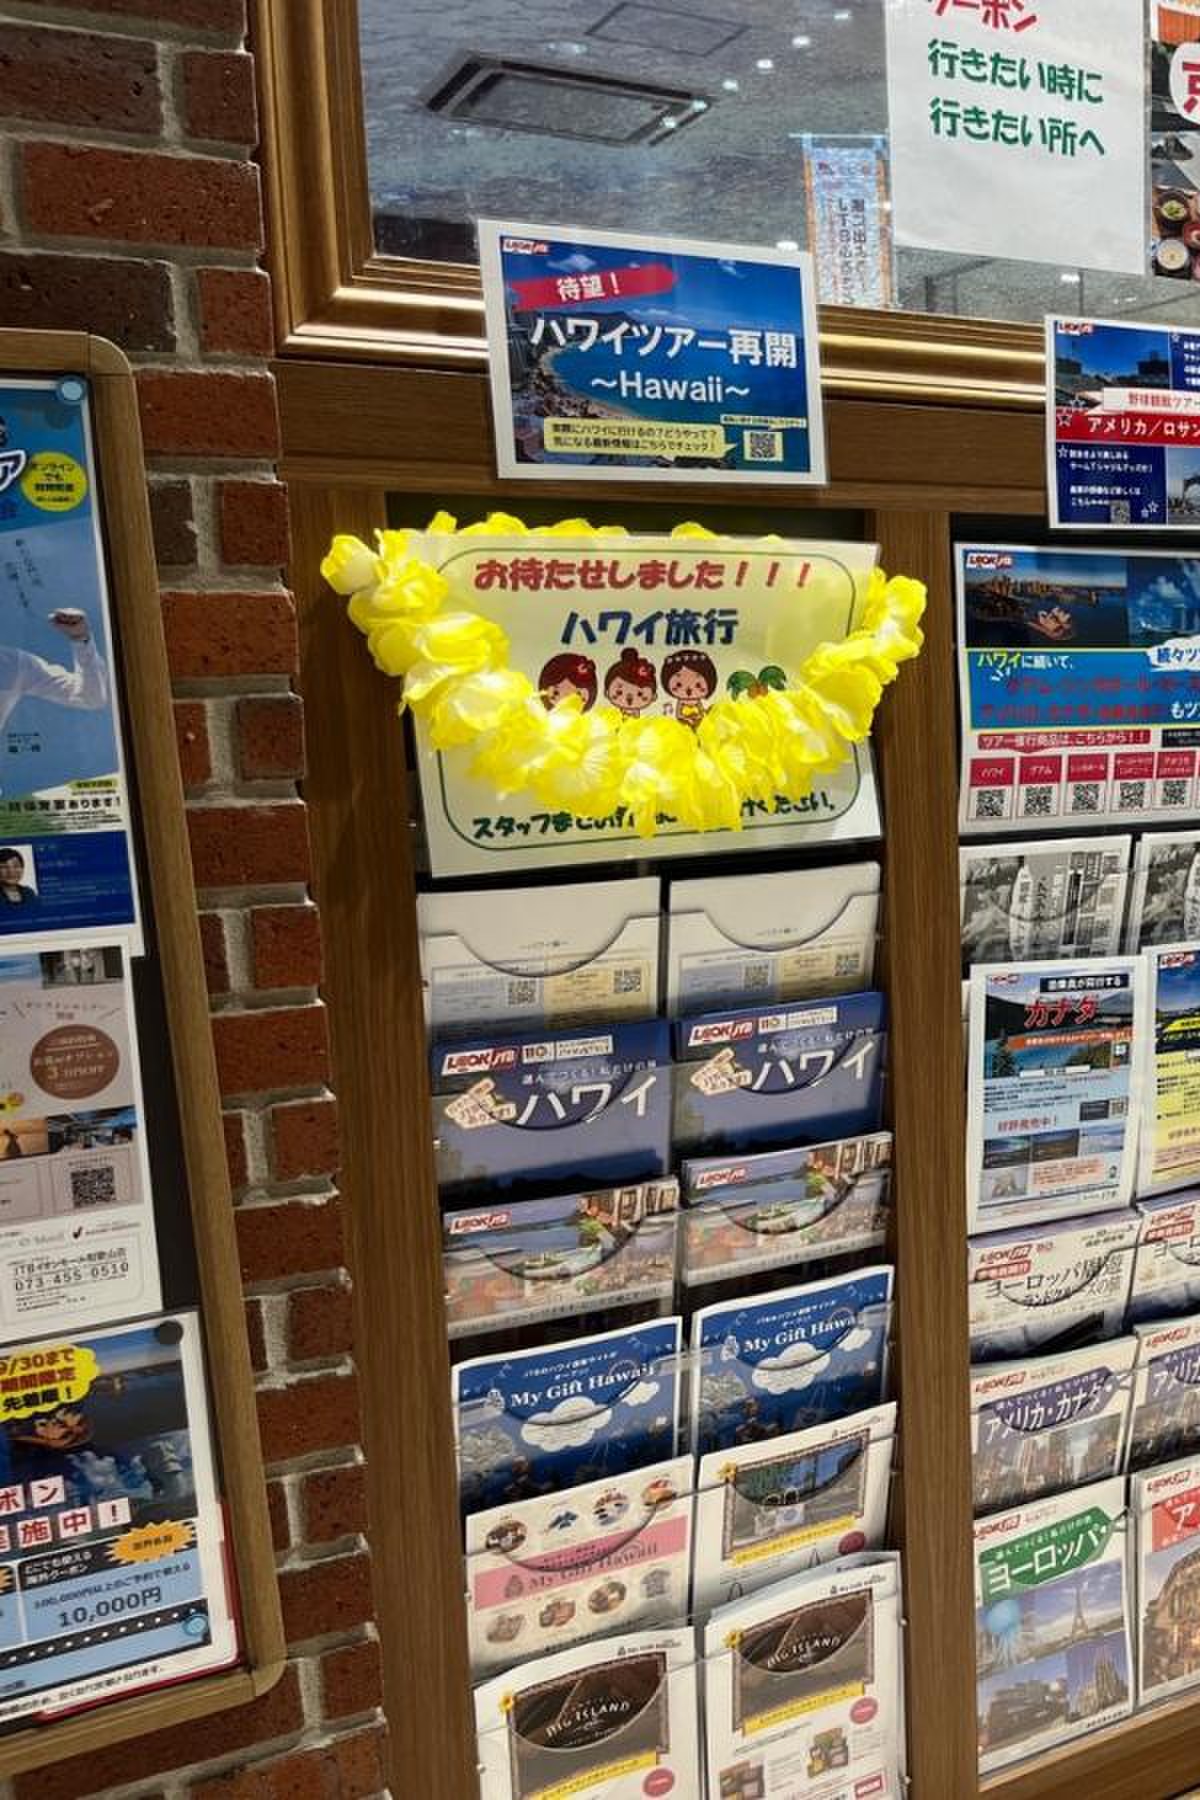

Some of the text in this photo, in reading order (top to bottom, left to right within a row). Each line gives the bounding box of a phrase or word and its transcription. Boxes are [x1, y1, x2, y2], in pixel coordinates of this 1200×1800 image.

[928, 38, 1104, 103] 行きたい時に
[929, 97, 1105, 157] 行きたい所へ
[556, 271, 621, 302] 待望！
[530, 317, 798, 369] ハワイツアー再開
[474, 558, 813, 592] お待たせしました！！！
[561, 608, 739, 646] ハワイ旅行
[1024, 995, 1100, 1029] カナダ
[751, 1041, 874, 1091] ハワイ
[515, 1074, 657, 1125] ハワイ
[743, 1334, 773, 1354] My
[774, 1326, 809, 1347] Gift
[511, 1361, 655, 1408] My Gift Hawaii
[987, 1523, 1107, 1595] ヨーロッパ
[60, 1585, 162, 1628] 10,000円
[791, 1634, 841, 1655] ISLAND
[575, 1700, 631, 1721] ISLAND
